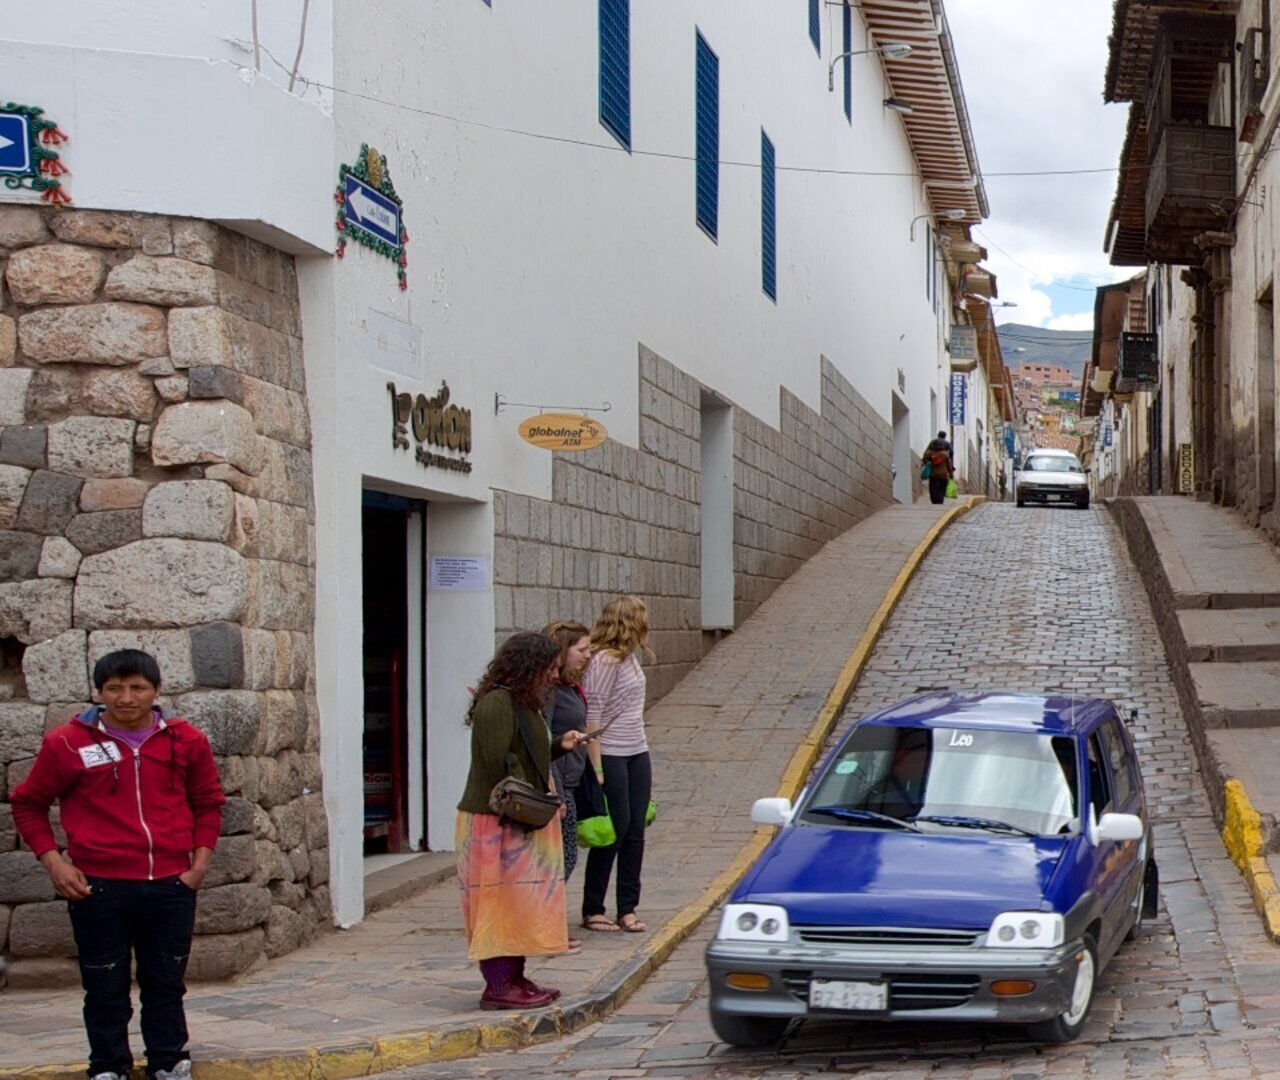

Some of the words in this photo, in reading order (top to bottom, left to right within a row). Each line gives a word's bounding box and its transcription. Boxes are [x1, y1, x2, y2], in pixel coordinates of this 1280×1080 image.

[952, 375, 963, 425] HOSPEDAJE
[528, 427, 583, 439] globalnet
[949, 729, 973, 747] Leo
